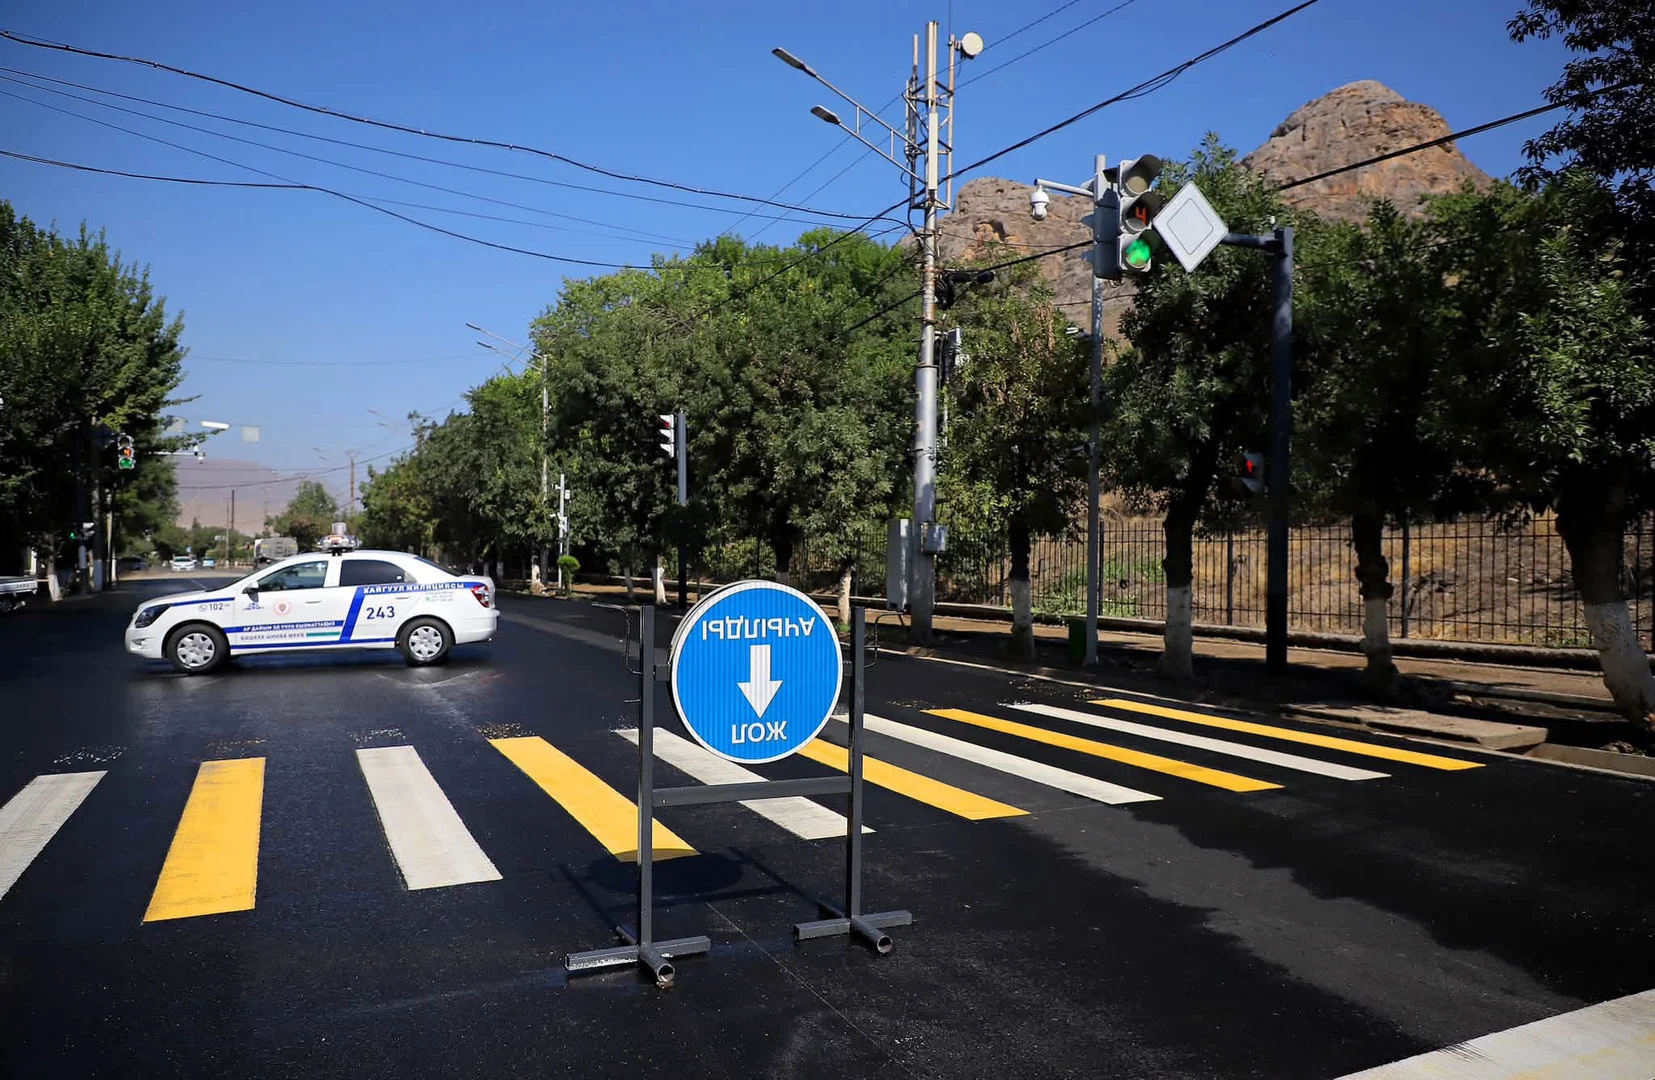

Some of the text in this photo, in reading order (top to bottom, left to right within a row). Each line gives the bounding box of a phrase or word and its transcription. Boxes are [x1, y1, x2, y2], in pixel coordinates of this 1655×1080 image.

[1135, 206, 1147, 226] 4
[363, 583, 465, 594] КАЙГУУЛ МИЛИЦИЯСЫ
[209, 602, 224, 611] 102
[366, 605, 395, 620] 243
[702, 615, 816, 641] АЧЫЛДЫ
[731, 720, 787, 744] ЖОЛ
